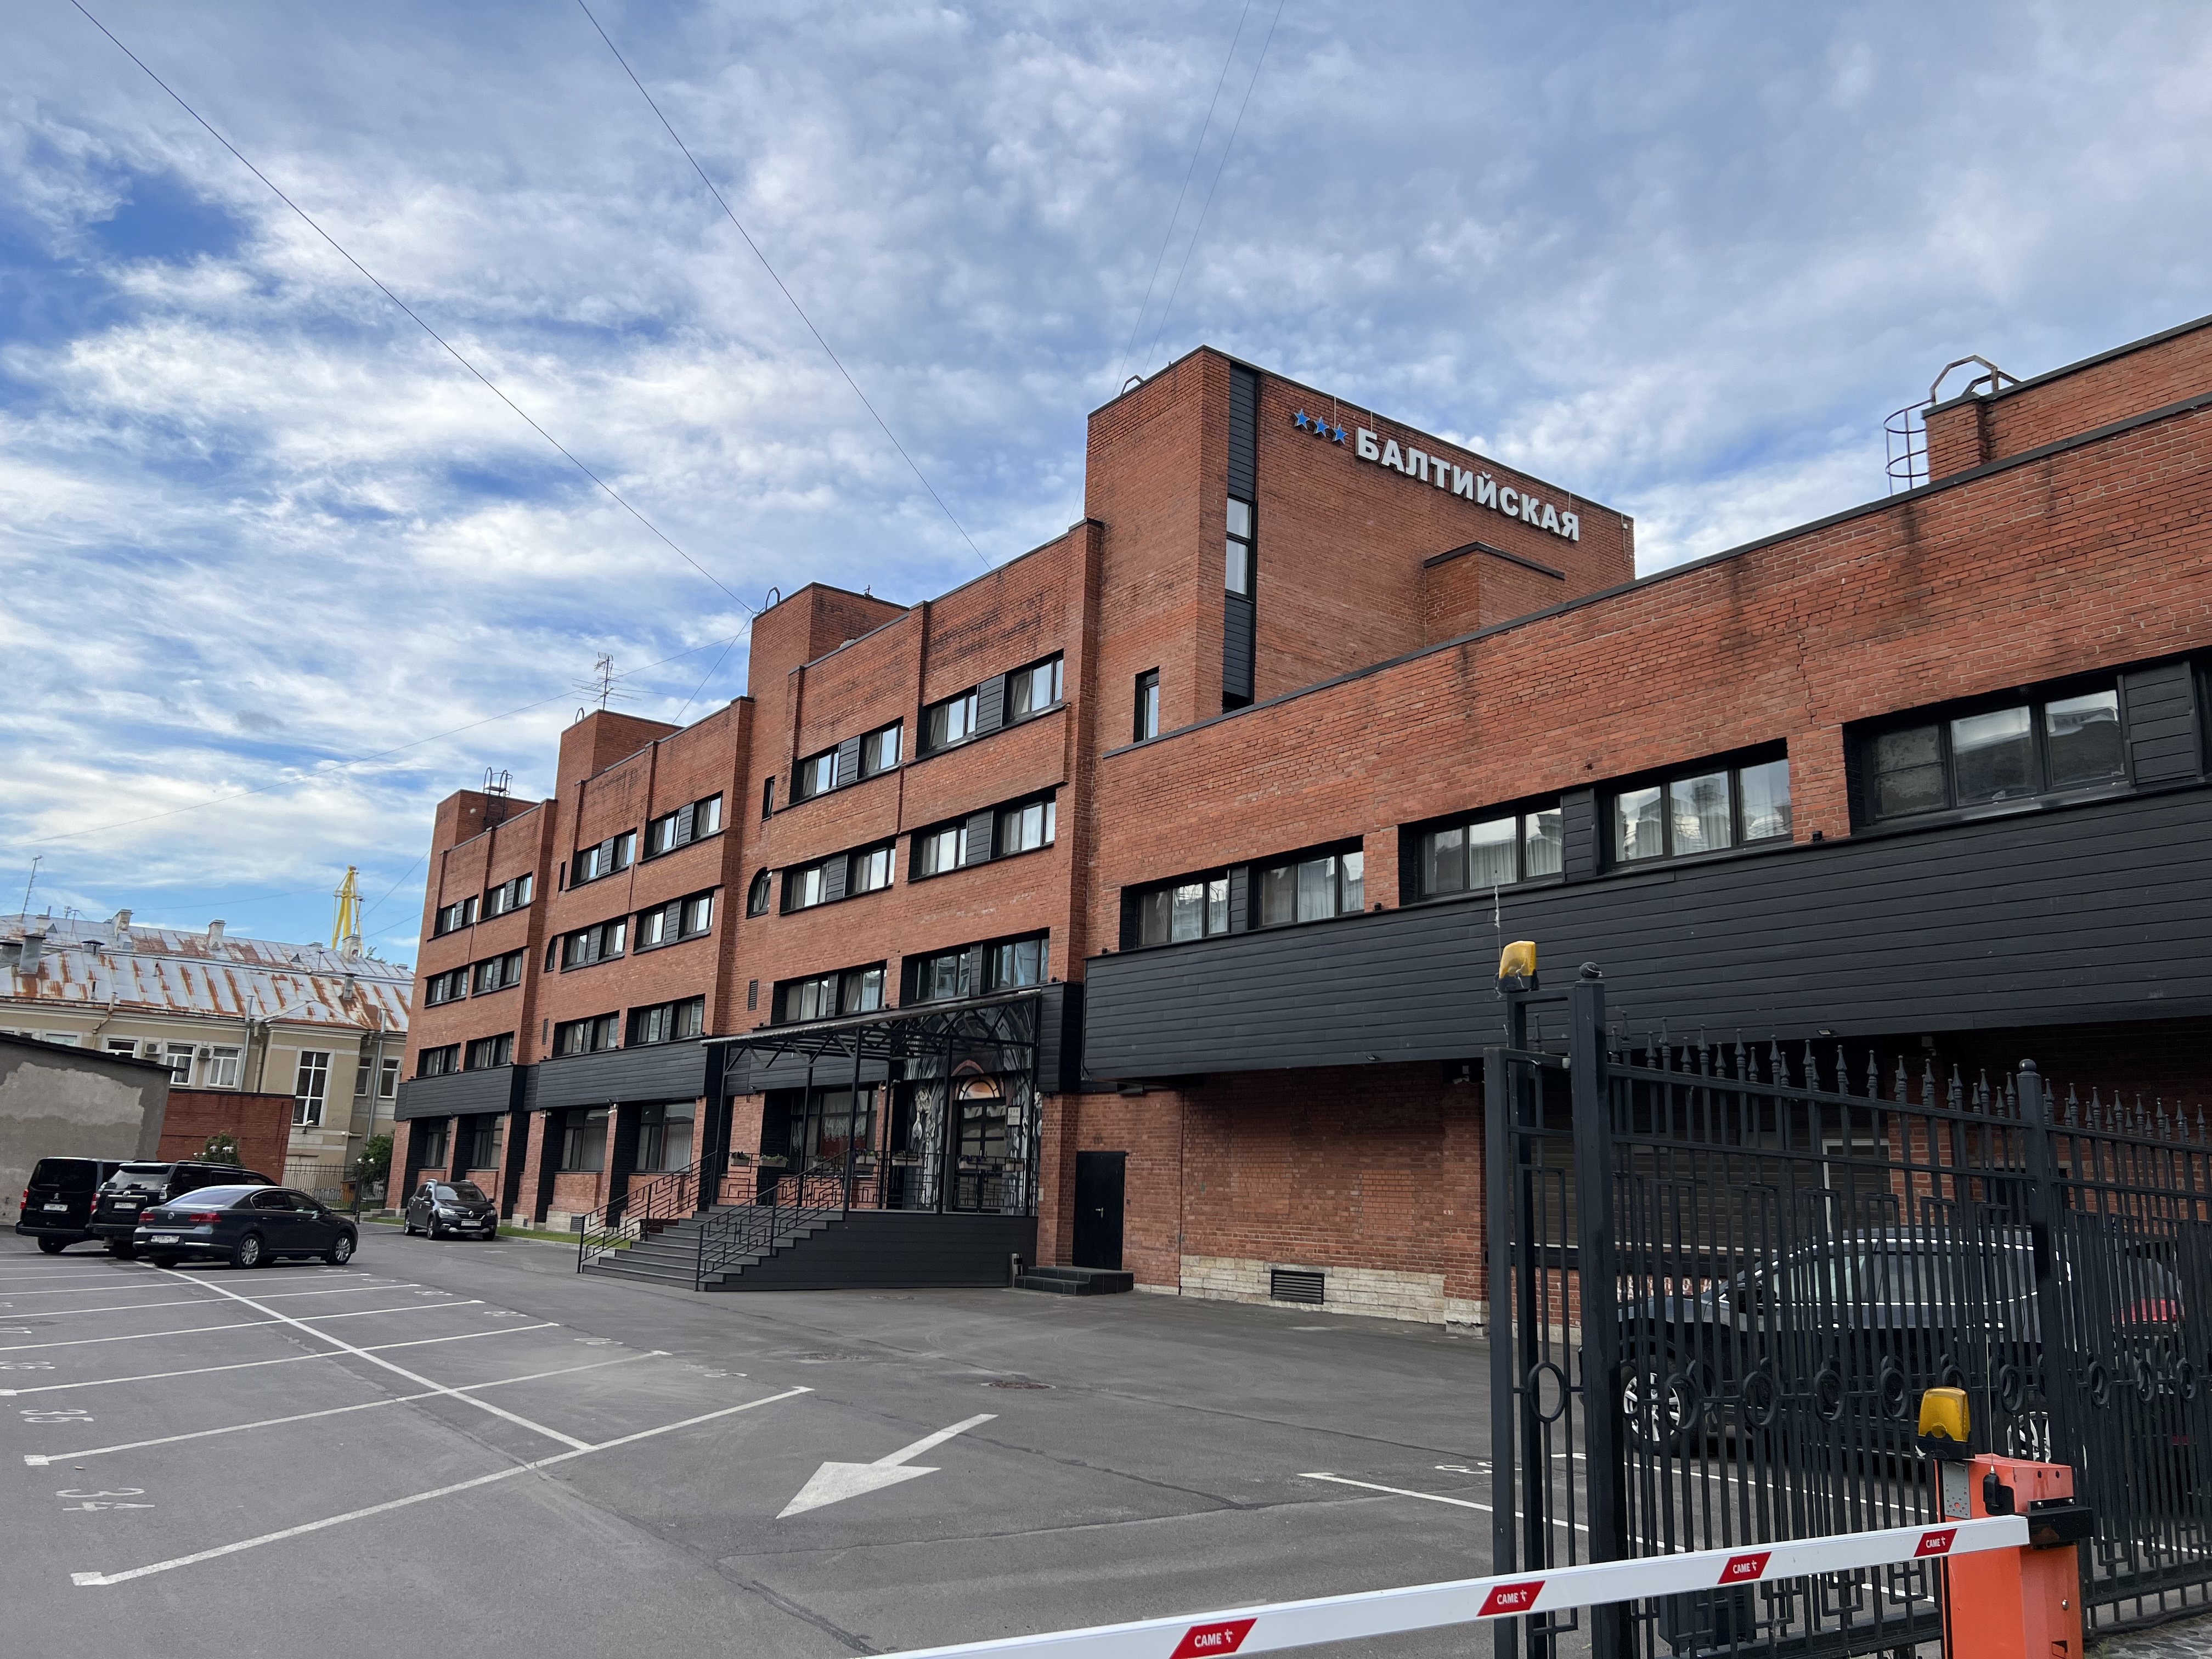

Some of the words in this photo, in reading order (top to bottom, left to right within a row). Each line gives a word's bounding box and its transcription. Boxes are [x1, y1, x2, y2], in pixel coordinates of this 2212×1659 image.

[1355, 427, 1579, 541] БАЛТИЙСКАЯ
[19, 1409, 94, 1423] 35
[55, 1487, 156, 1512] 34
[1926, 1538, 1940, 1548] CAME
[1733, 1562, 1751, 1574] CAME
[1497, 1592, 1519, 1605] CAME
[1194, 1632, 1222, 1647] CAME
